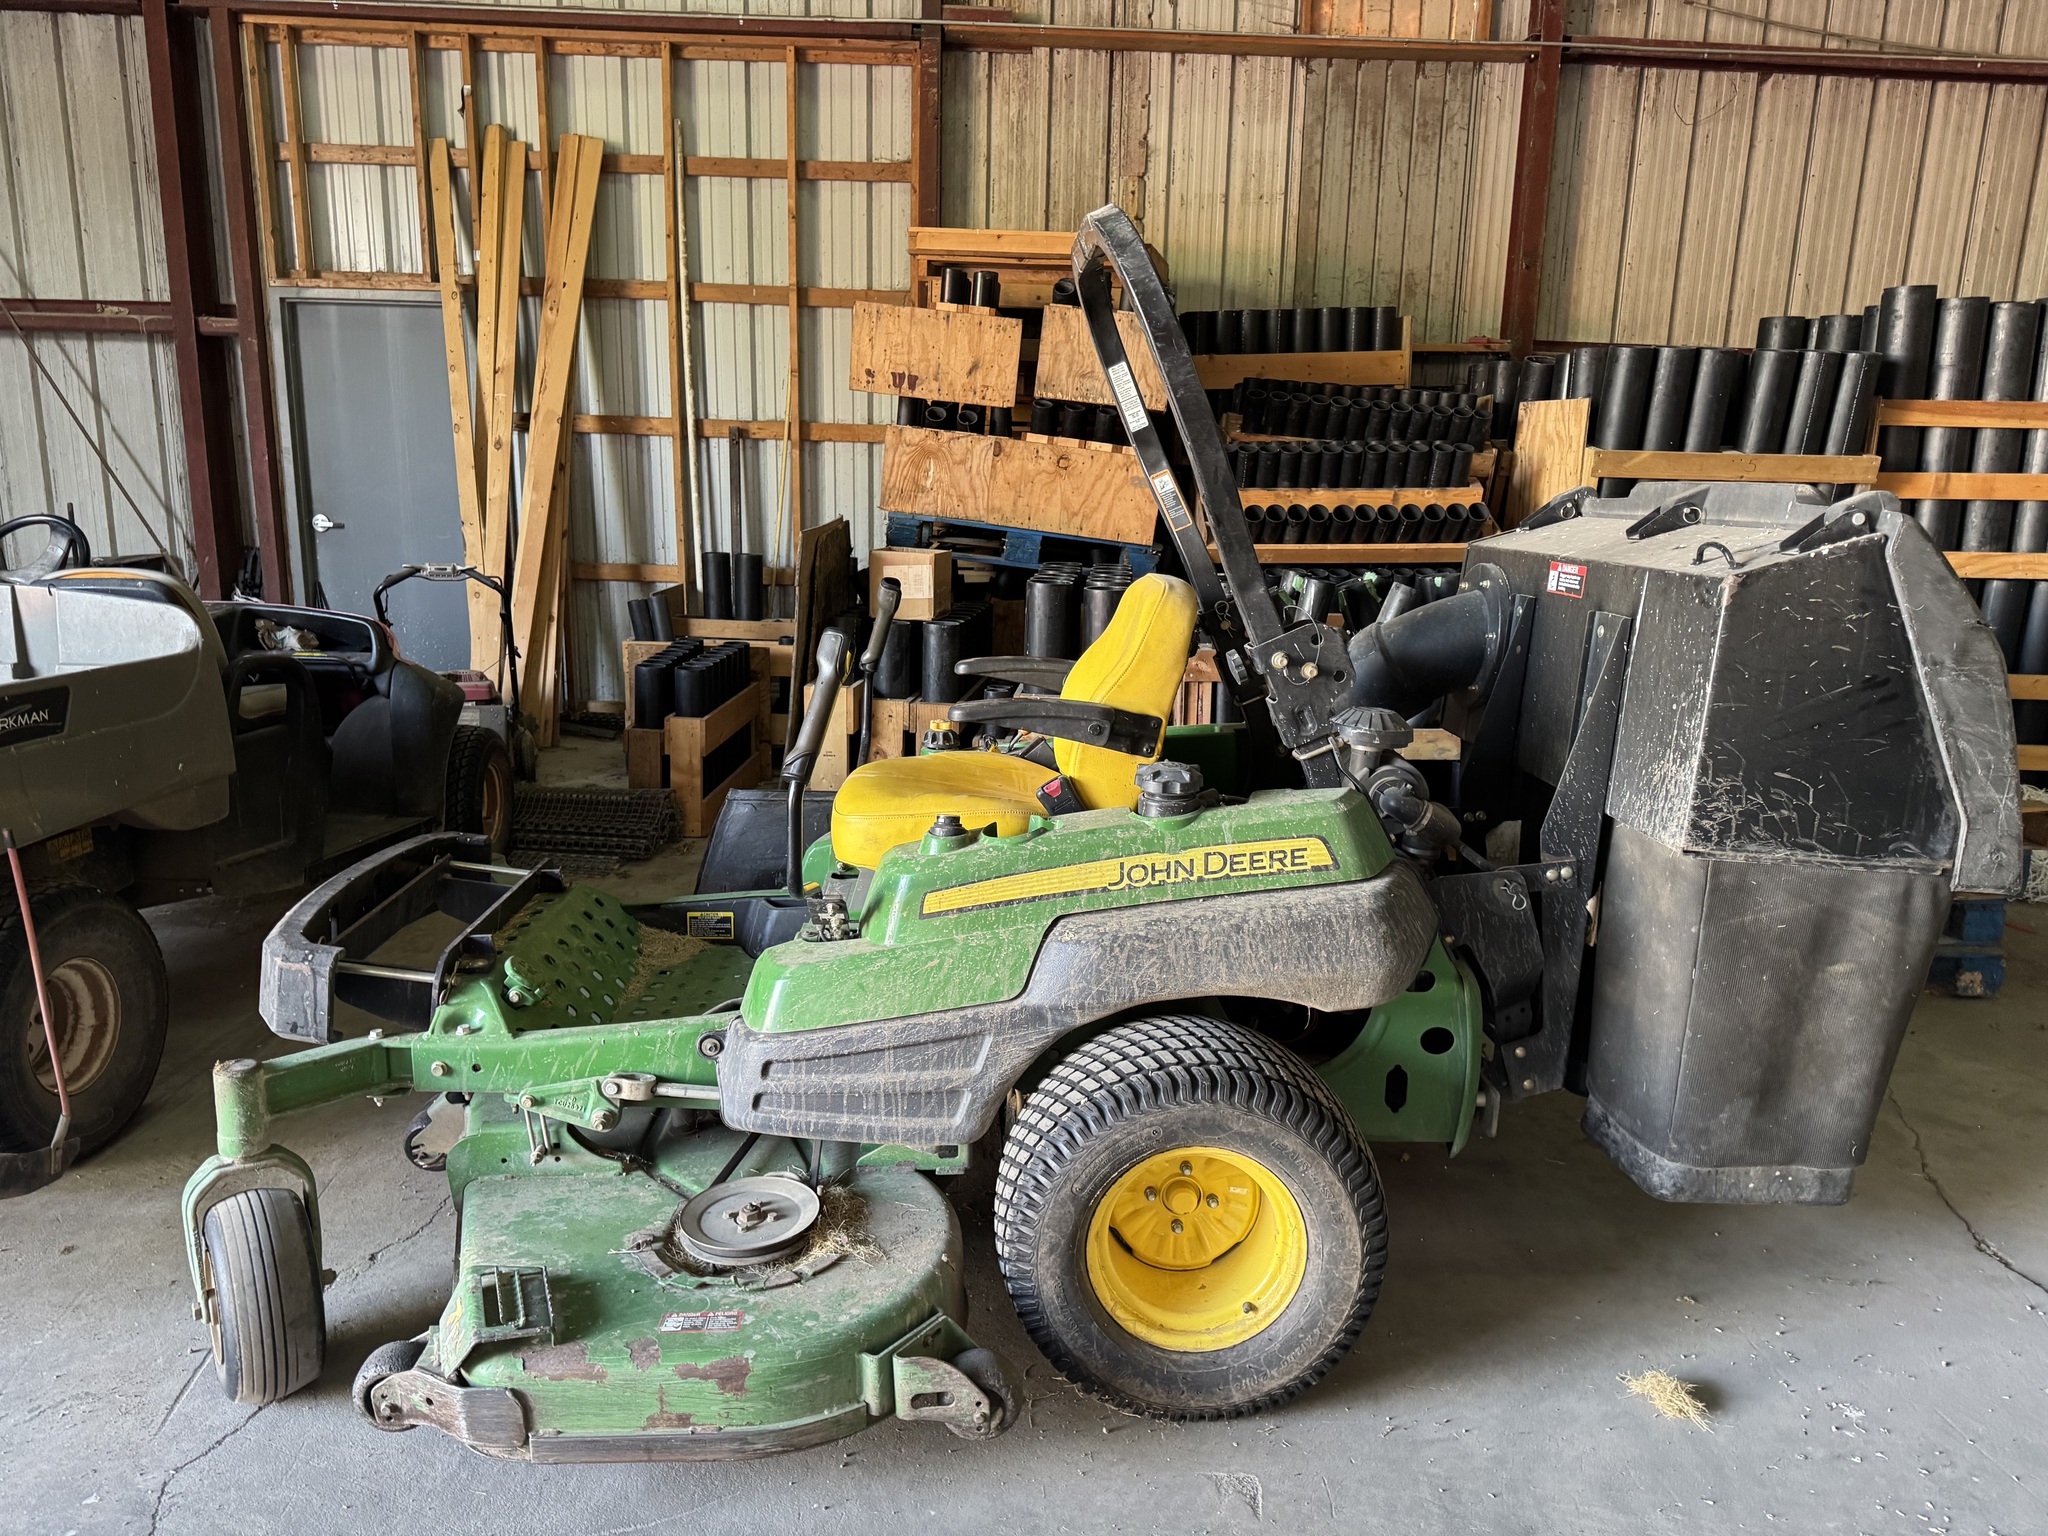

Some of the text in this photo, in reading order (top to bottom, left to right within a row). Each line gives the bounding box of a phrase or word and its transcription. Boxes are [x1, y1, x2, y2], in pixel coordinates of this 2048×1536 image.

[1743, 458, 1758, 473] 5
[1562, 563, 1579, 575] DANGER
[1108, 847, 1308, 888] JOHN DEERE
